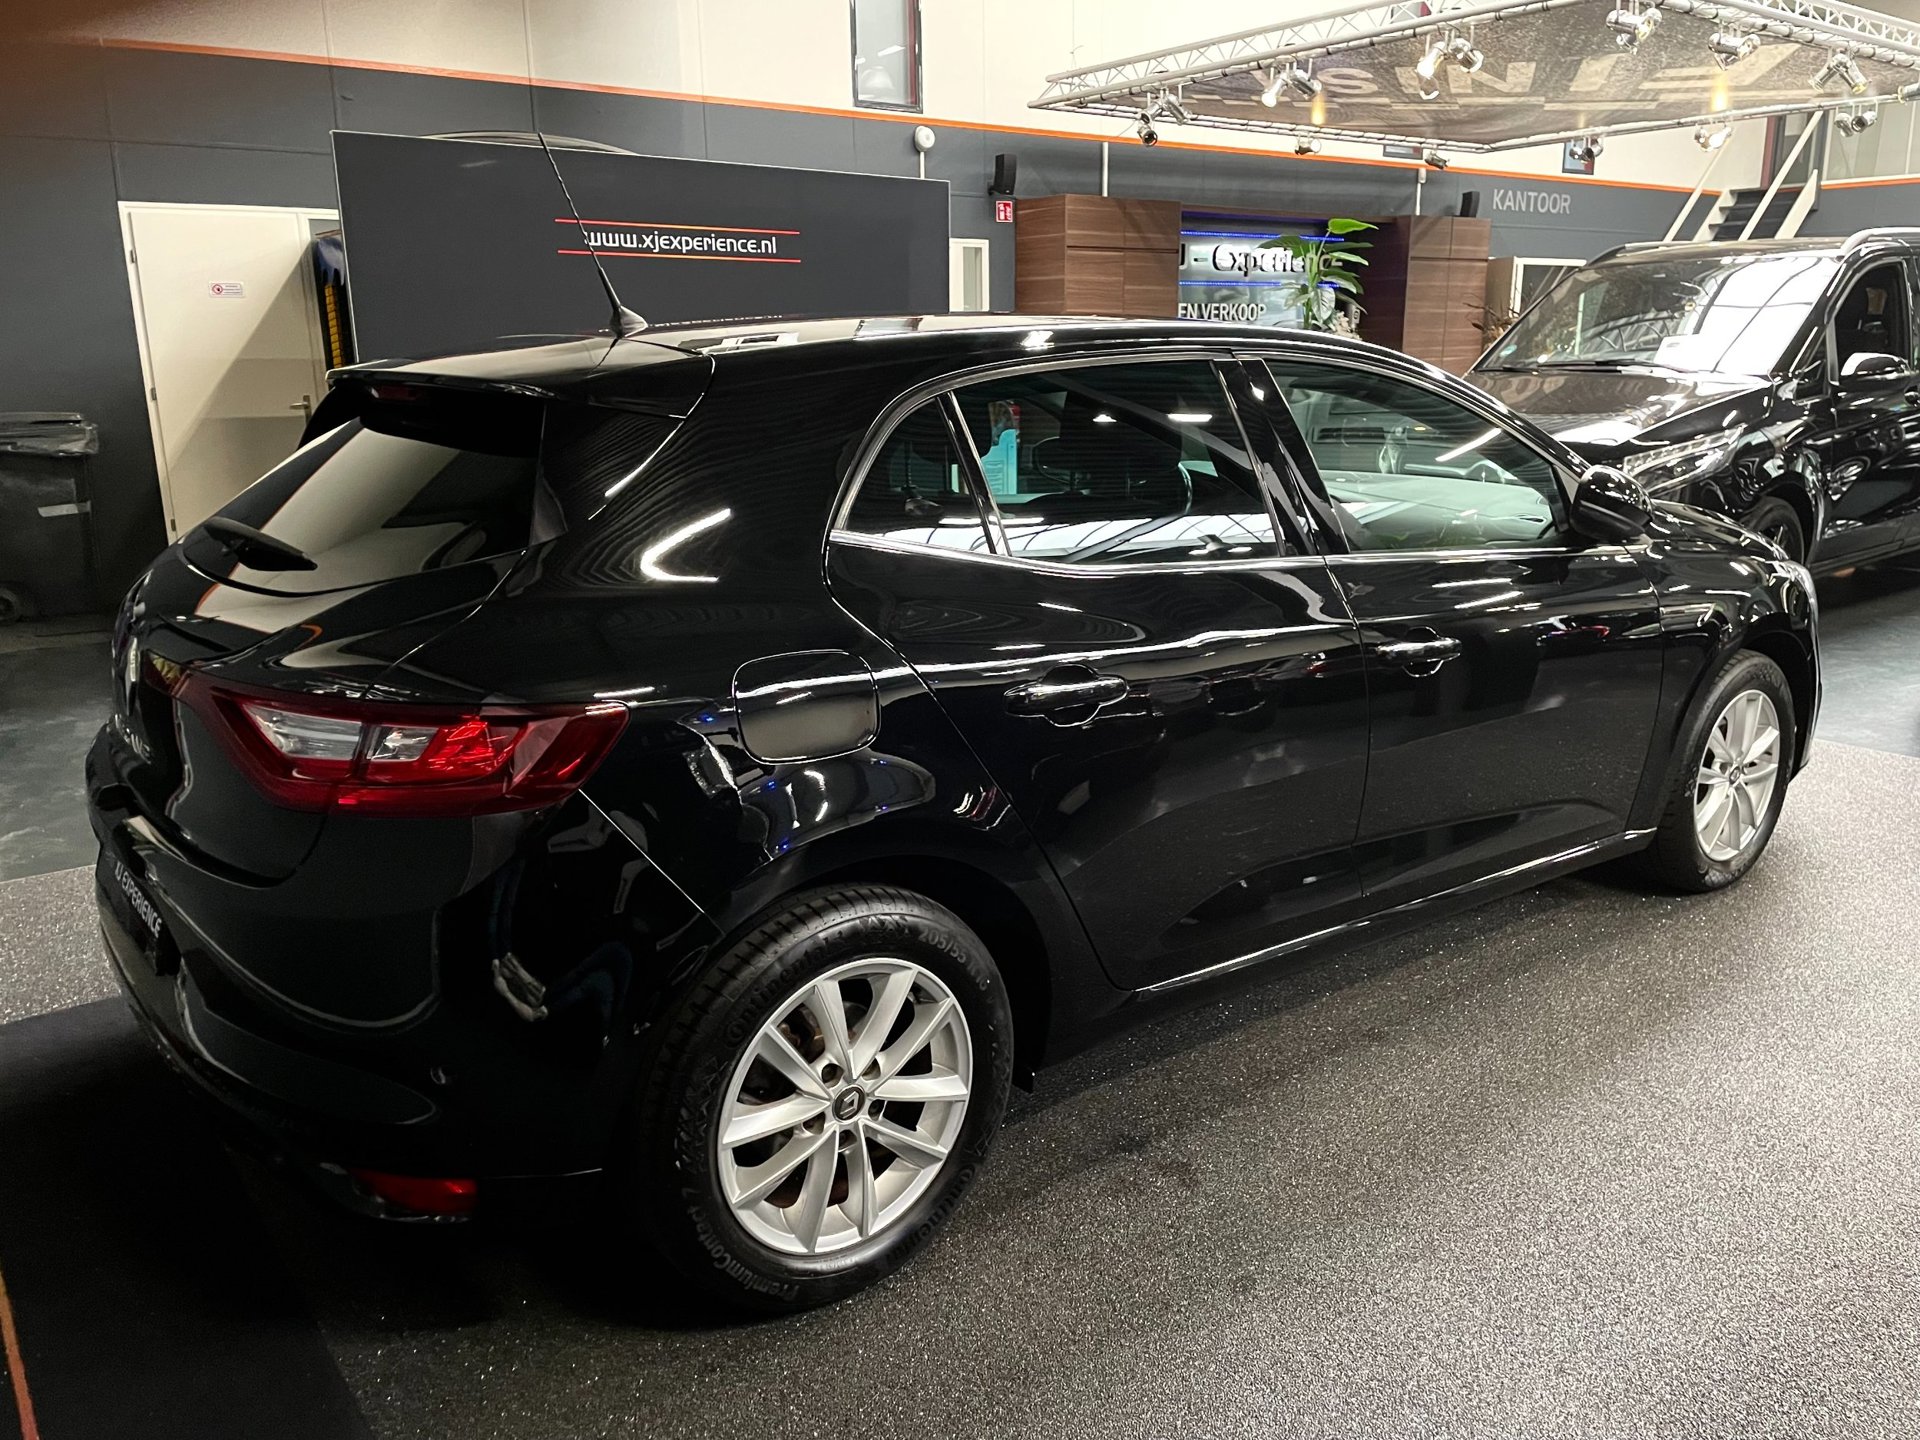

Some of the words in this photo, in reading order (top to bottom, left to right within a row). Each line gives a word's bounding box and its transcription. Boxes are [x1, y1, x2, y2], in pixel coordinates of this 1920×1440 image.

[1492, 188, 1571, 215] KANTOOR
[584, 231, 777, 253] www.xjexperience.nl
[1178, 302, 1198, 320] EN
[1201, 303, 1267, 322] VERKOOP
